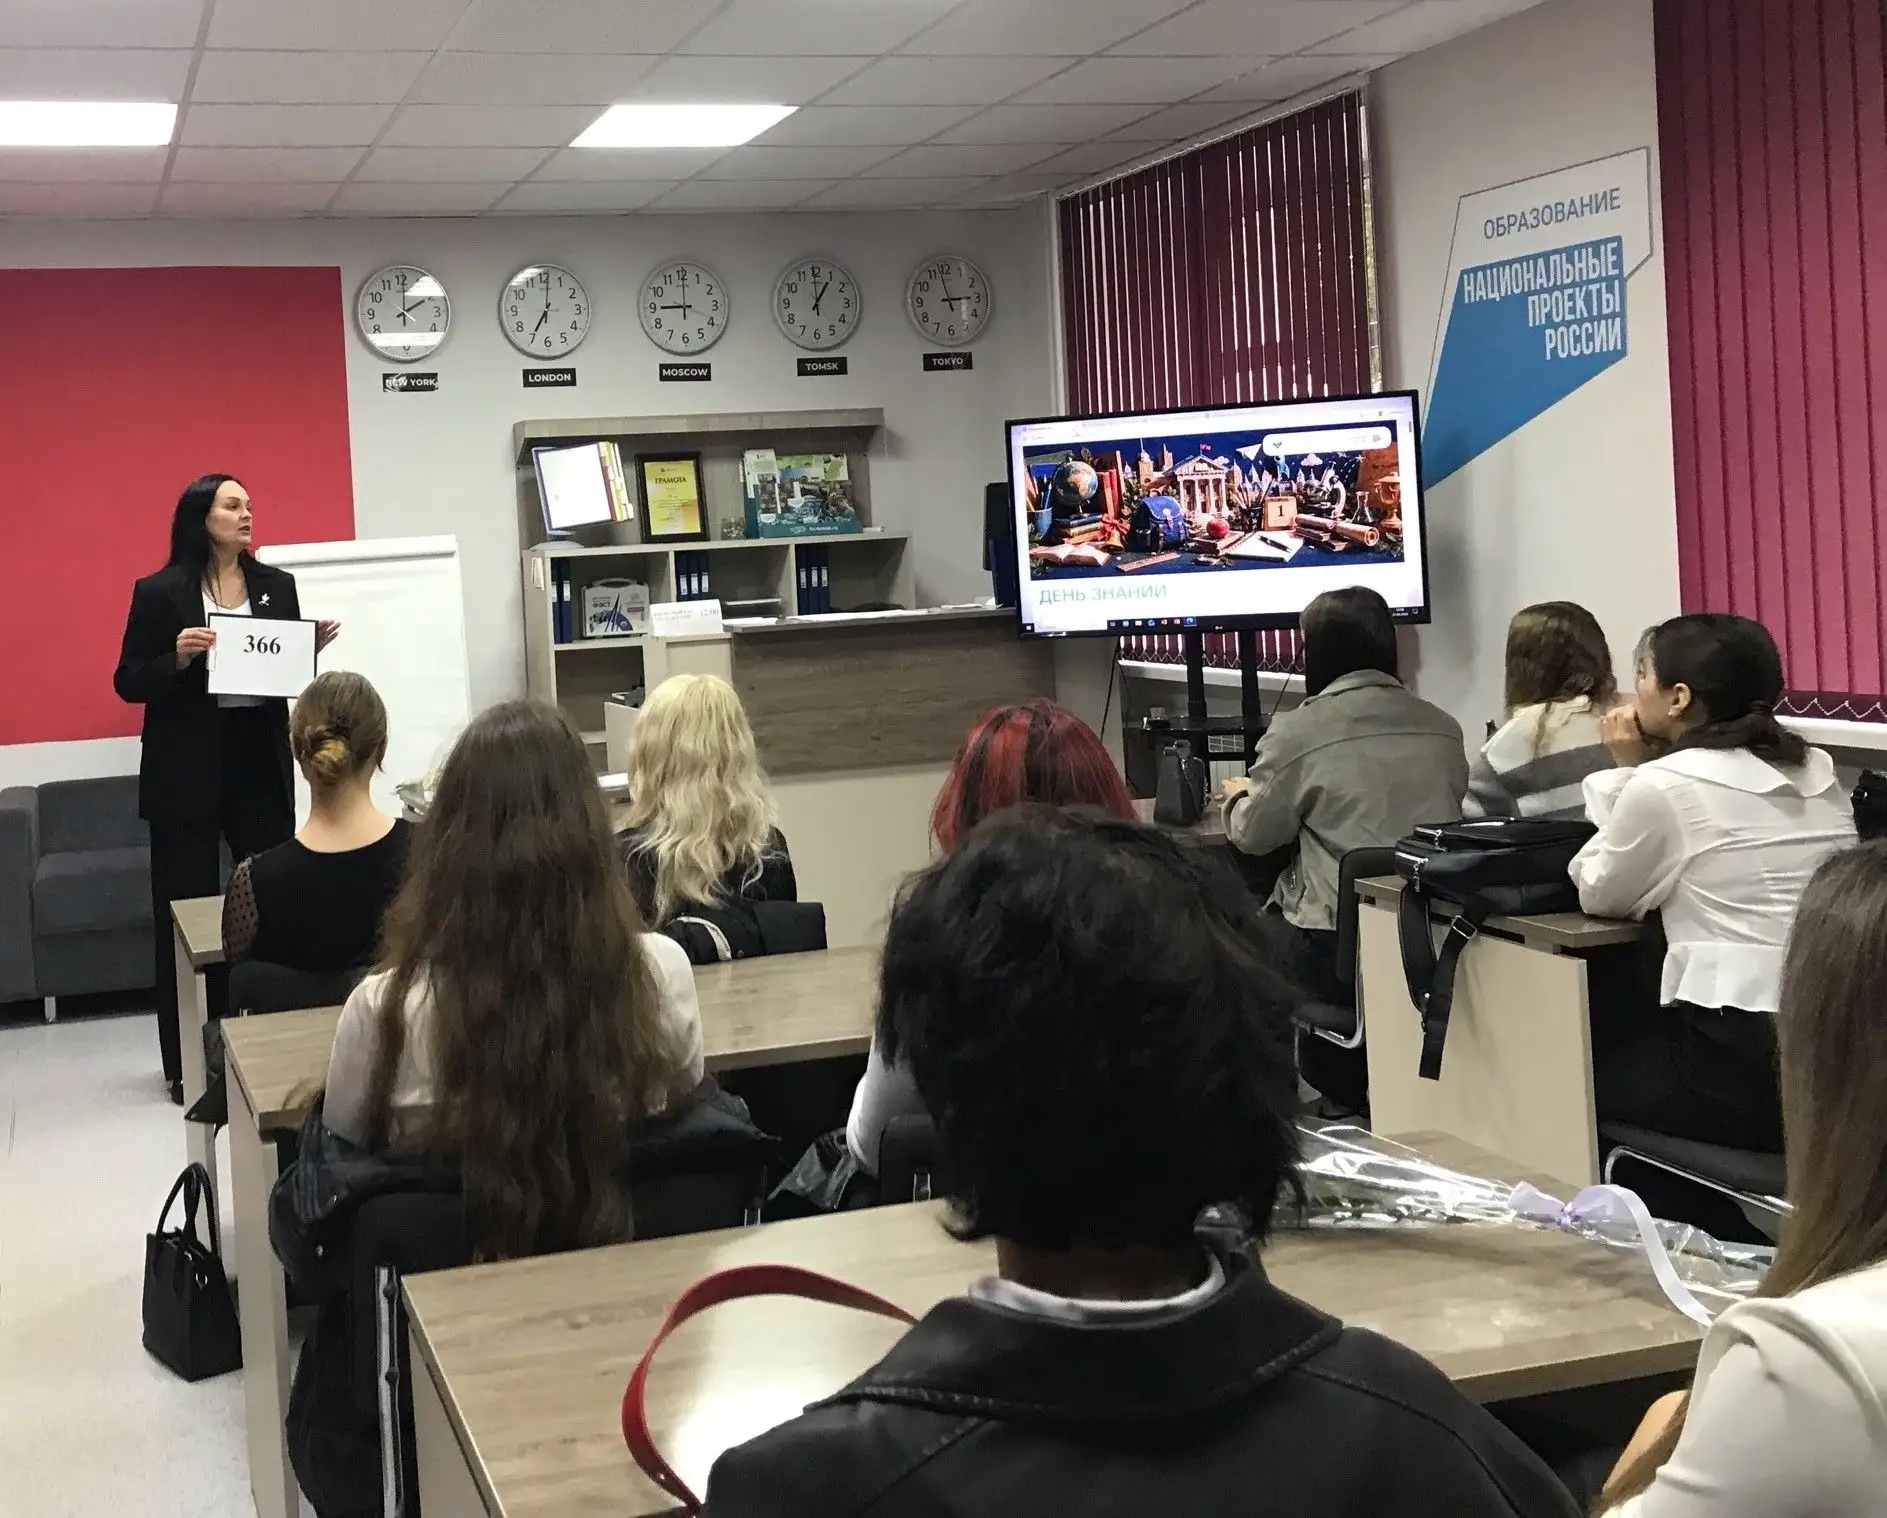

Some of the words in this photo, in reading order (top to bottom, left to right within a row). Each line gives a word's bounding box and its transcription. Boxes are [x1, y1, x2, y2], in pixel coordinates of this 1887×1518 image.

[1484, 187, 1621, 239] ОБРАЗОВАНИЕ
[928, 269, 937, 279] 11
[940, 263, 951, 275] 12
[1463, 241, 1619, 304] НАЦИОНАЛЬНЫЕ
[539, 272, 550, 284] 12
[663, 274, 672, 285] 11
[797, 270, 806, 282] 11
[381, 280, 391, 290] 11
[786, 282, 798, 294] 10
[838, 282, 846, 293] 2
[917, 281, 929, 292] 10
[969, 277, 975, 288] 2
[513, 289, 525, 300] 10
[569, 288, 576, 299] 2
[652, 286, 664, 297] 10
[706, 284, 714, 295] 2
[369, 292, 382, 303] 10
[843, 297, 850, 309] 3
[916, 296, 923, 308] 9
[1528, 279, 1620, 327] ПРОЕКТЫ
[649, 302, 656, 313] 9
[711, 300, 718, 311] 3
[783, 298, 790, 309] 9
[367, 308, 375, 320] 9
[434, 306, 441, 317] 3
[510, 305, 518, 316] 9
[575, 304, 582, 315] 3
[971, 308, 978, 318] 4
[707, 316, 714, 327] 4
[787, 313, 795, 324] 8
[838, 313, 846, 324] 4
[921, 312, 929, 322] 8
[516, 321, 524, 332] 8
[570, 320, 578, 331] 4
[654, 318, 662, 329] 8
[934, 322, 940, 333] 7
[668, 329, 674, 340] 7
[697, 328, 704, 340] 5
[800, 325, 806, 336] 7
[813, 328, 821, 340] 6
[829, 324, 836, 336] 5
[947, 325, 955, 336] 6
[529, 333, 536, 344] 7
[544, 336, 552, 348] 6
[560, 332, 567, 343] 5
[682, 333, 689, 344] 6
[1545, 317, 1621, 361] РОССИИ
[805, 362, 838, 372] TOMSK
[932, 357, 964, 366] TOKYO
[528, 373, 572, 382] LONDON
[662, 368, 708, 377] MOSCOW
[654, 476, 687, 484] ГРАМОТА
[1278, 505, 1285, 517] 1
[1040, 589, 1086, 605] ДЕНЬ
[243, 634, 281, 655] 366
